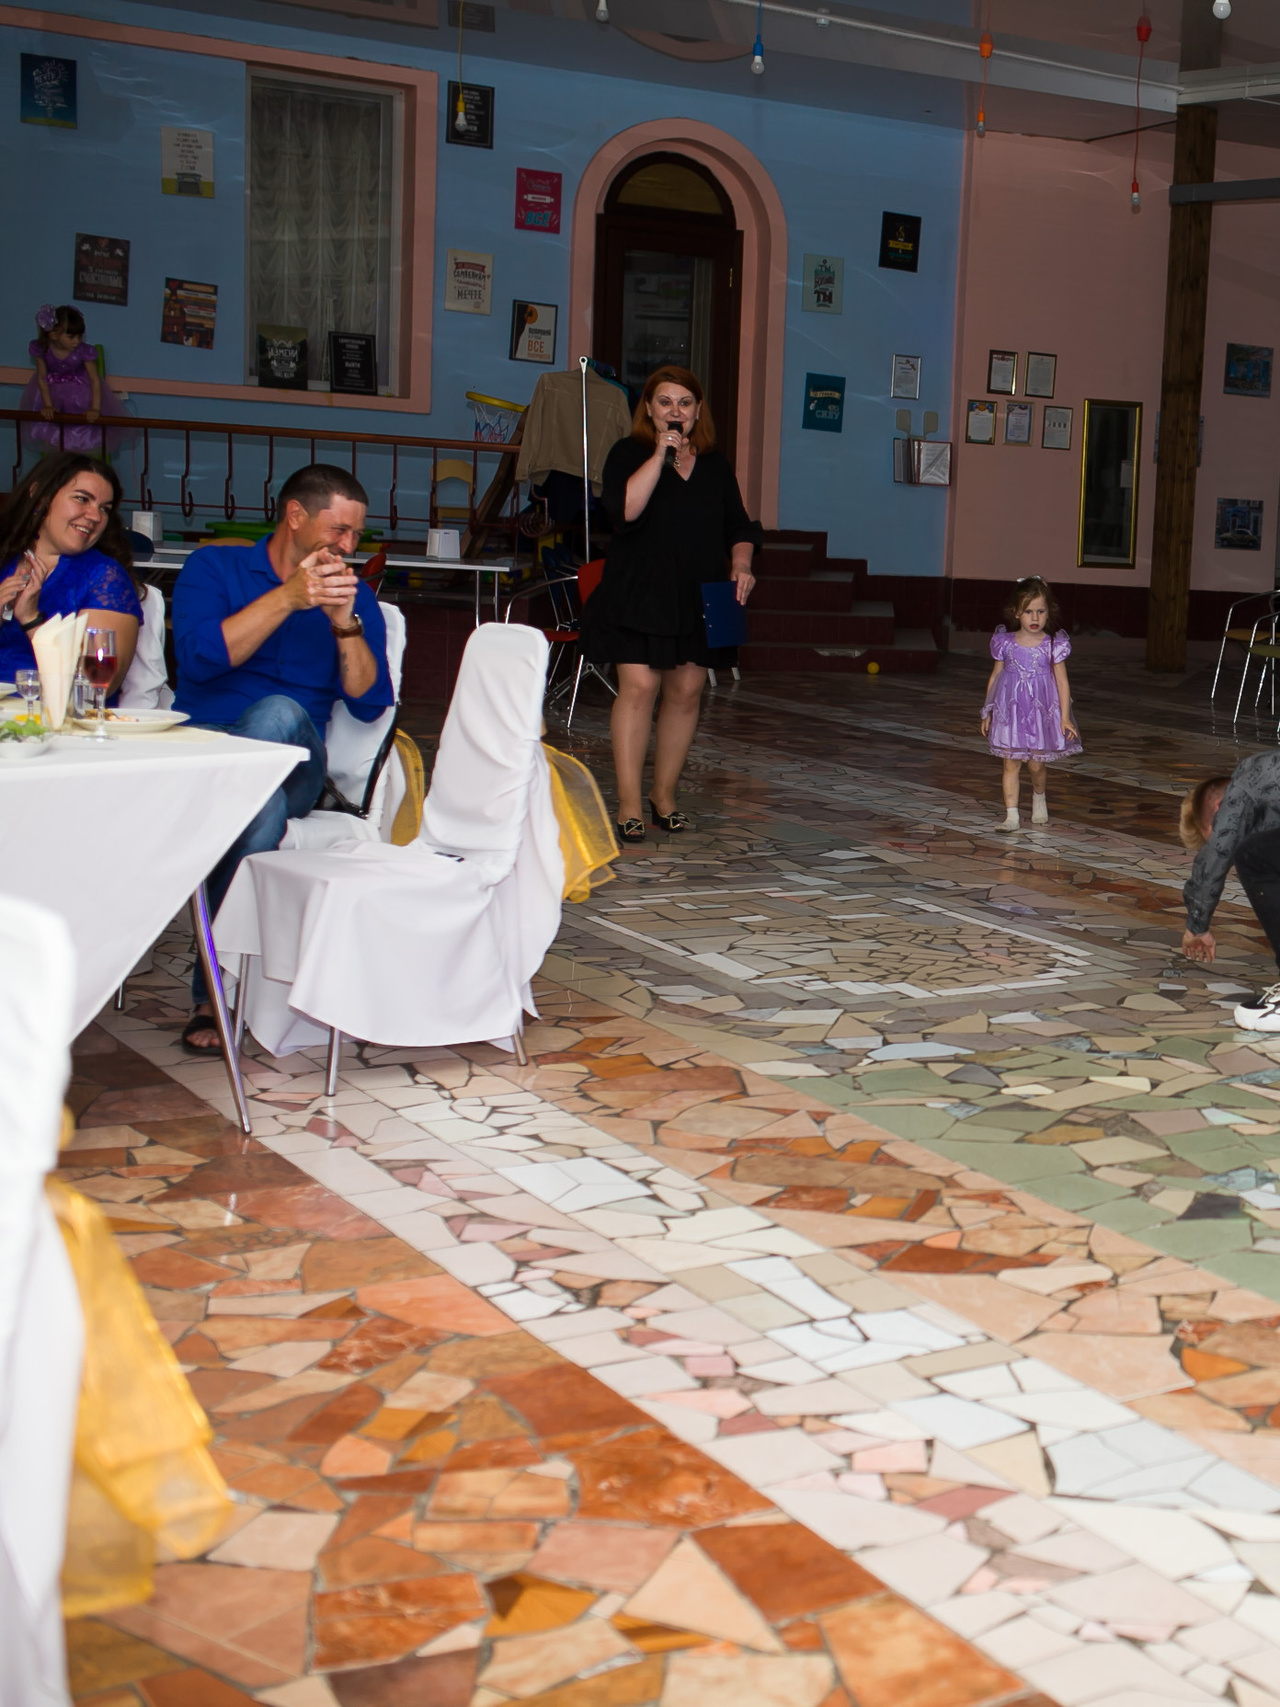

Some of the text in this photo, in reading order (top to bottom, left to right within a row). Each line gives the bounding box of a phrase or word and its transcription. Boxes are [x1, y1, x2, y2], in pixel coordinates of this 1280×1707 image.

[457, 290, 482, 300] МЕЧТЕ
[528, 340, 544, 353] ВСЕ
[267, 347, 298, 361] ИЗМЕНИ
